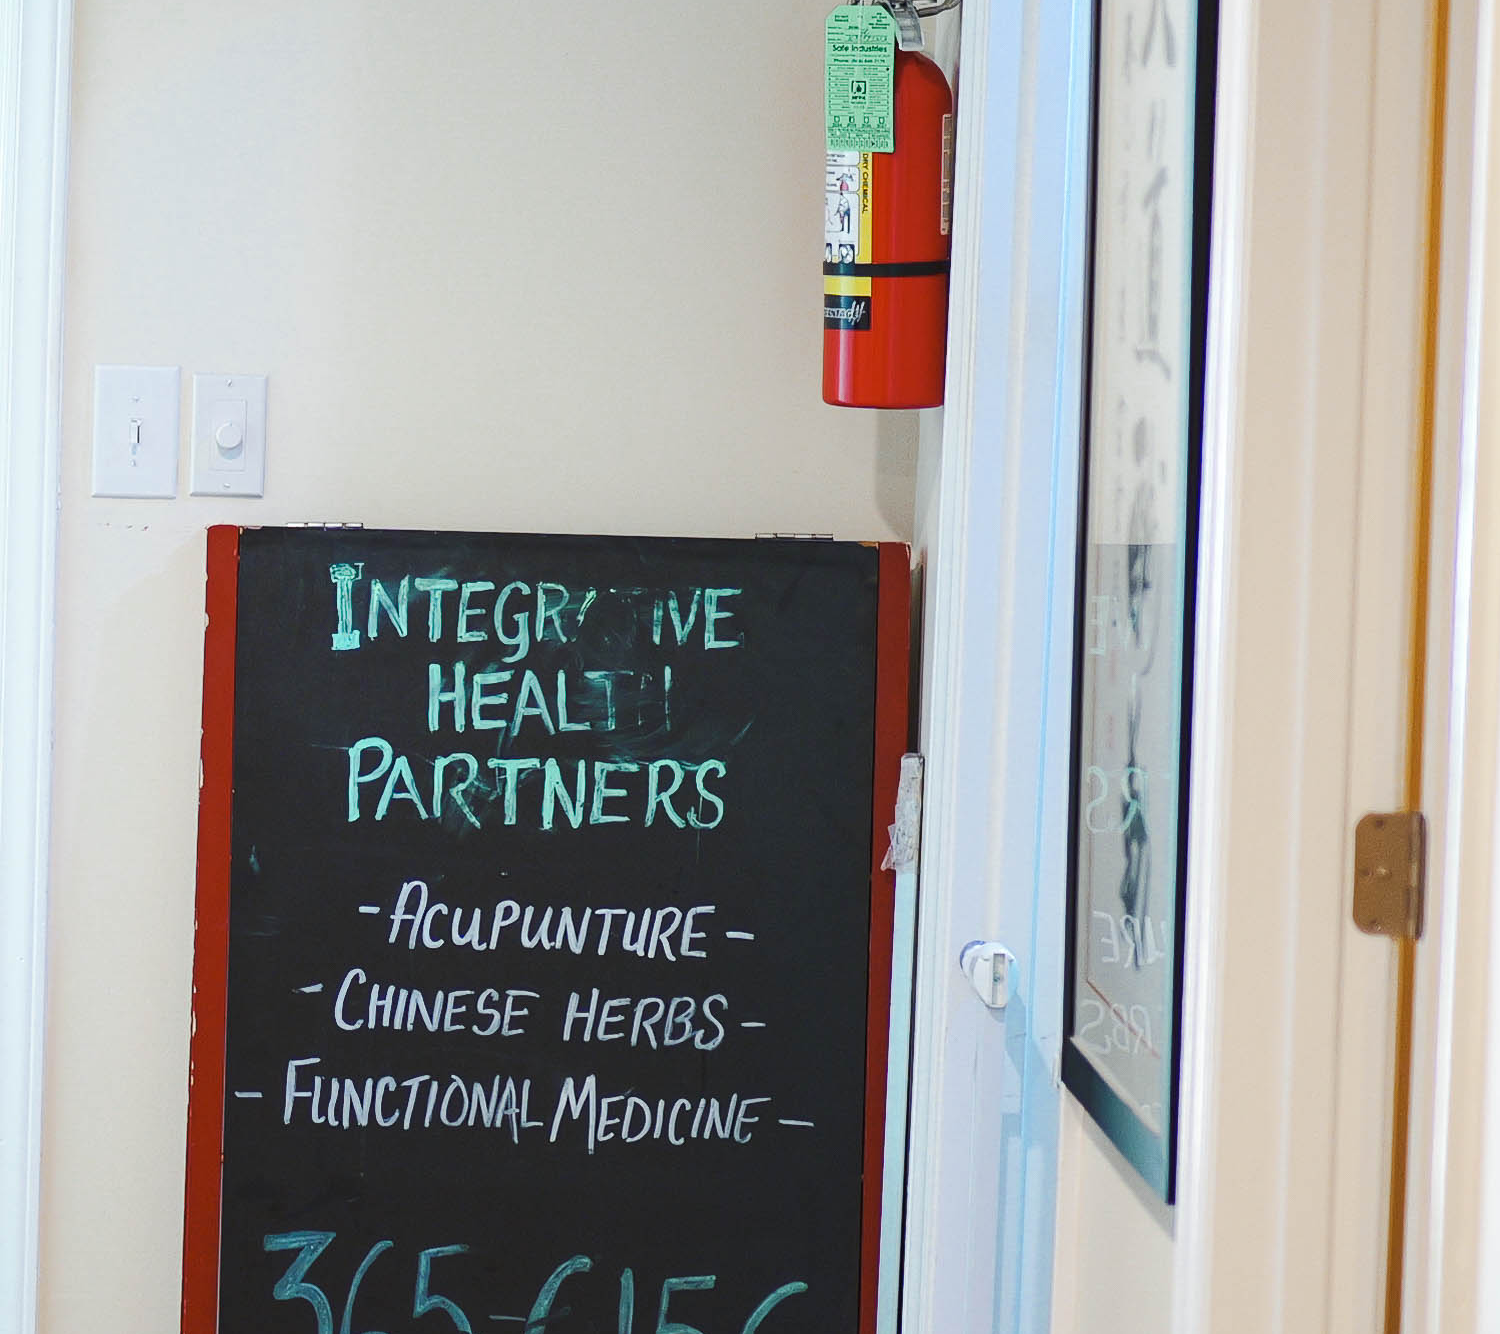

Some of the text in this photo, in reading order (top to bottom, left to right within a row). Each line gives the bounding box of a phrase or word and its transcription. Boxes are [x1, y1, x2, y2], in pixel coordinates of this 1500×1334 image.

[832, 44, 888, 53] Safe Industries
[330, 563, 744, 663] INTEGRIVE
[346, 736, 727, 831] PARTNERS
